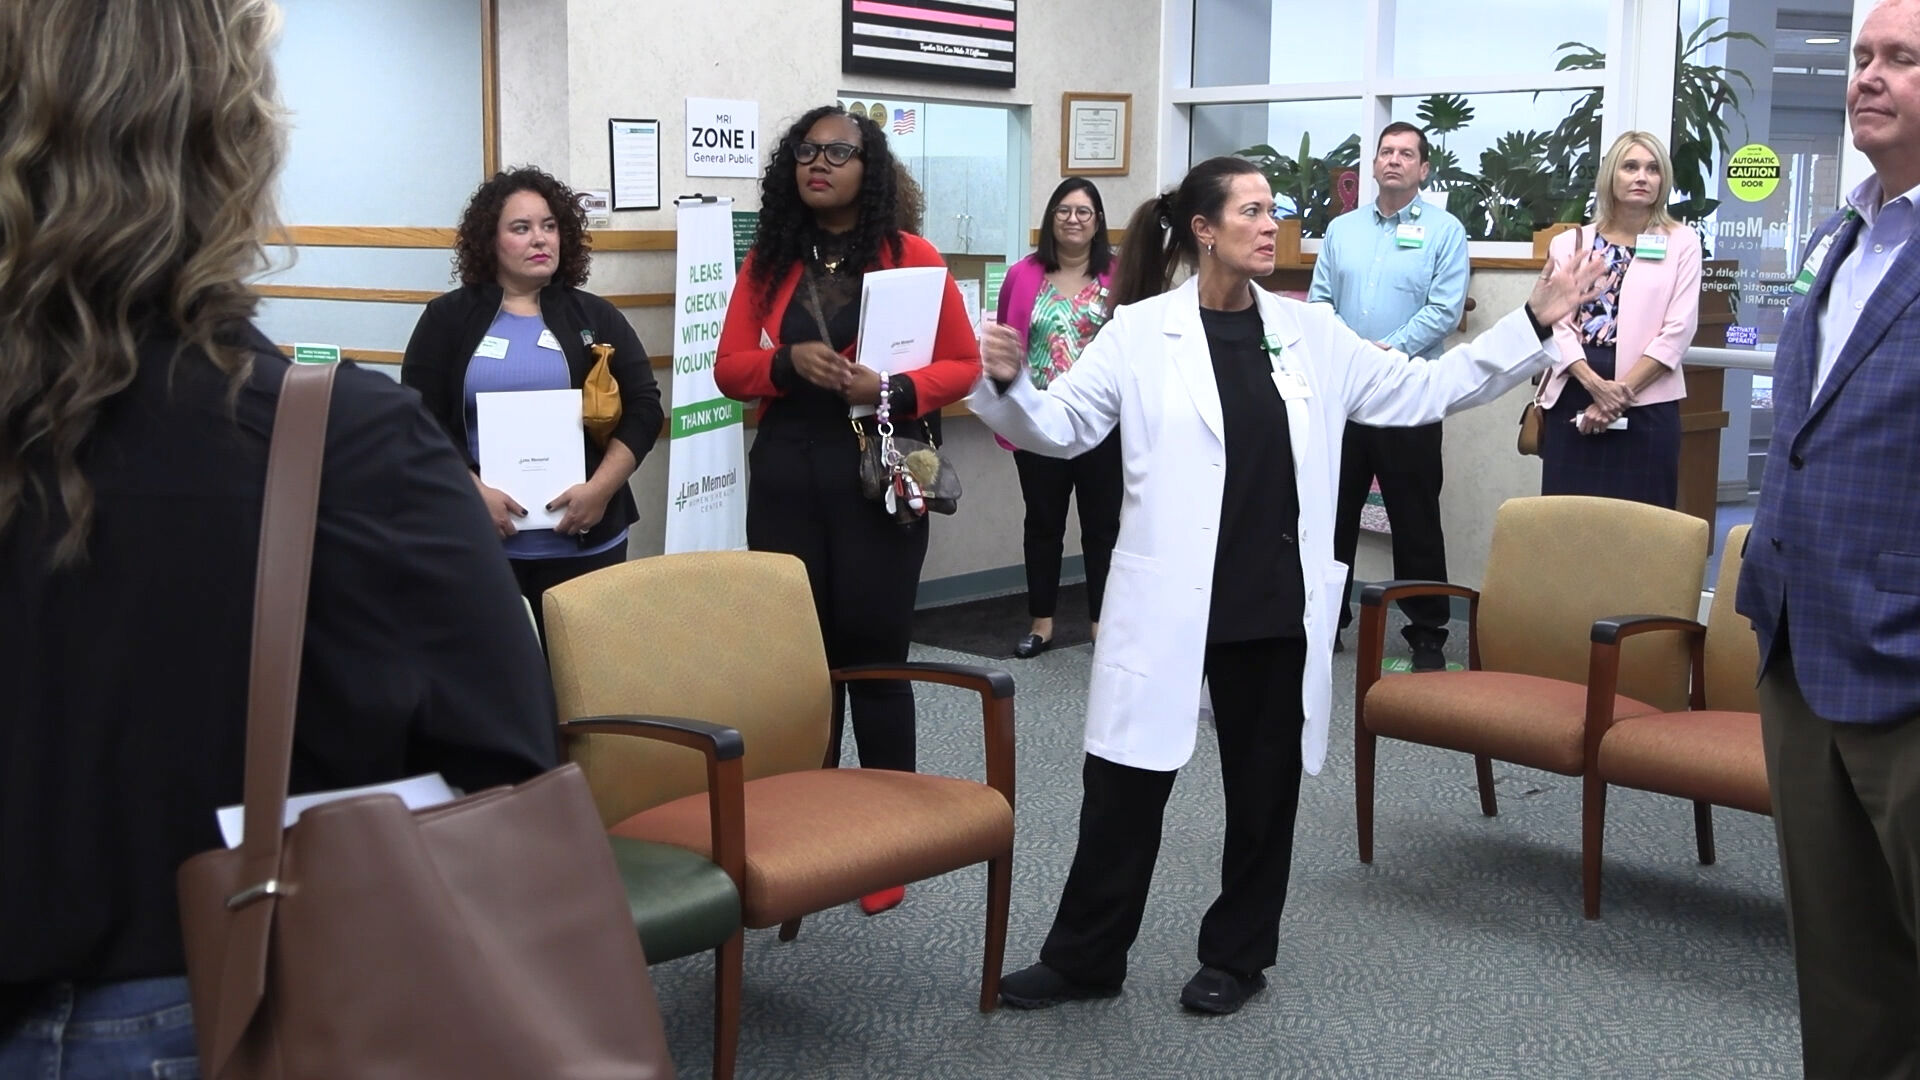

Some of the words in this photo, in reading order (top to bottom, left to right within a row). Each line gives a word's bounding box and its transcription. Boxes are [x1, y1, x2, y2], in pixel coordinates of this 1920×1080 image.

[716, 114, 732, 124] MRI
[692, 127, 744, 149] ZONE
[693, 152, 726, 164] General
[728, 153, 753, 165] Public
[1730, 167, 1777, 177] CAUTION
[689, 262, 723, 284] PLEASE
[684, 293, 717, 315] CHECK
[719, 290, 727, 307] IN
[682, 323, 709, 345] WITH
[680, 410, 712, 430] THANK
[713, 404, 732, 423] YOU!
[682, 481, 699, 499] Lima
[702, 467, 737, 494] Memorial
